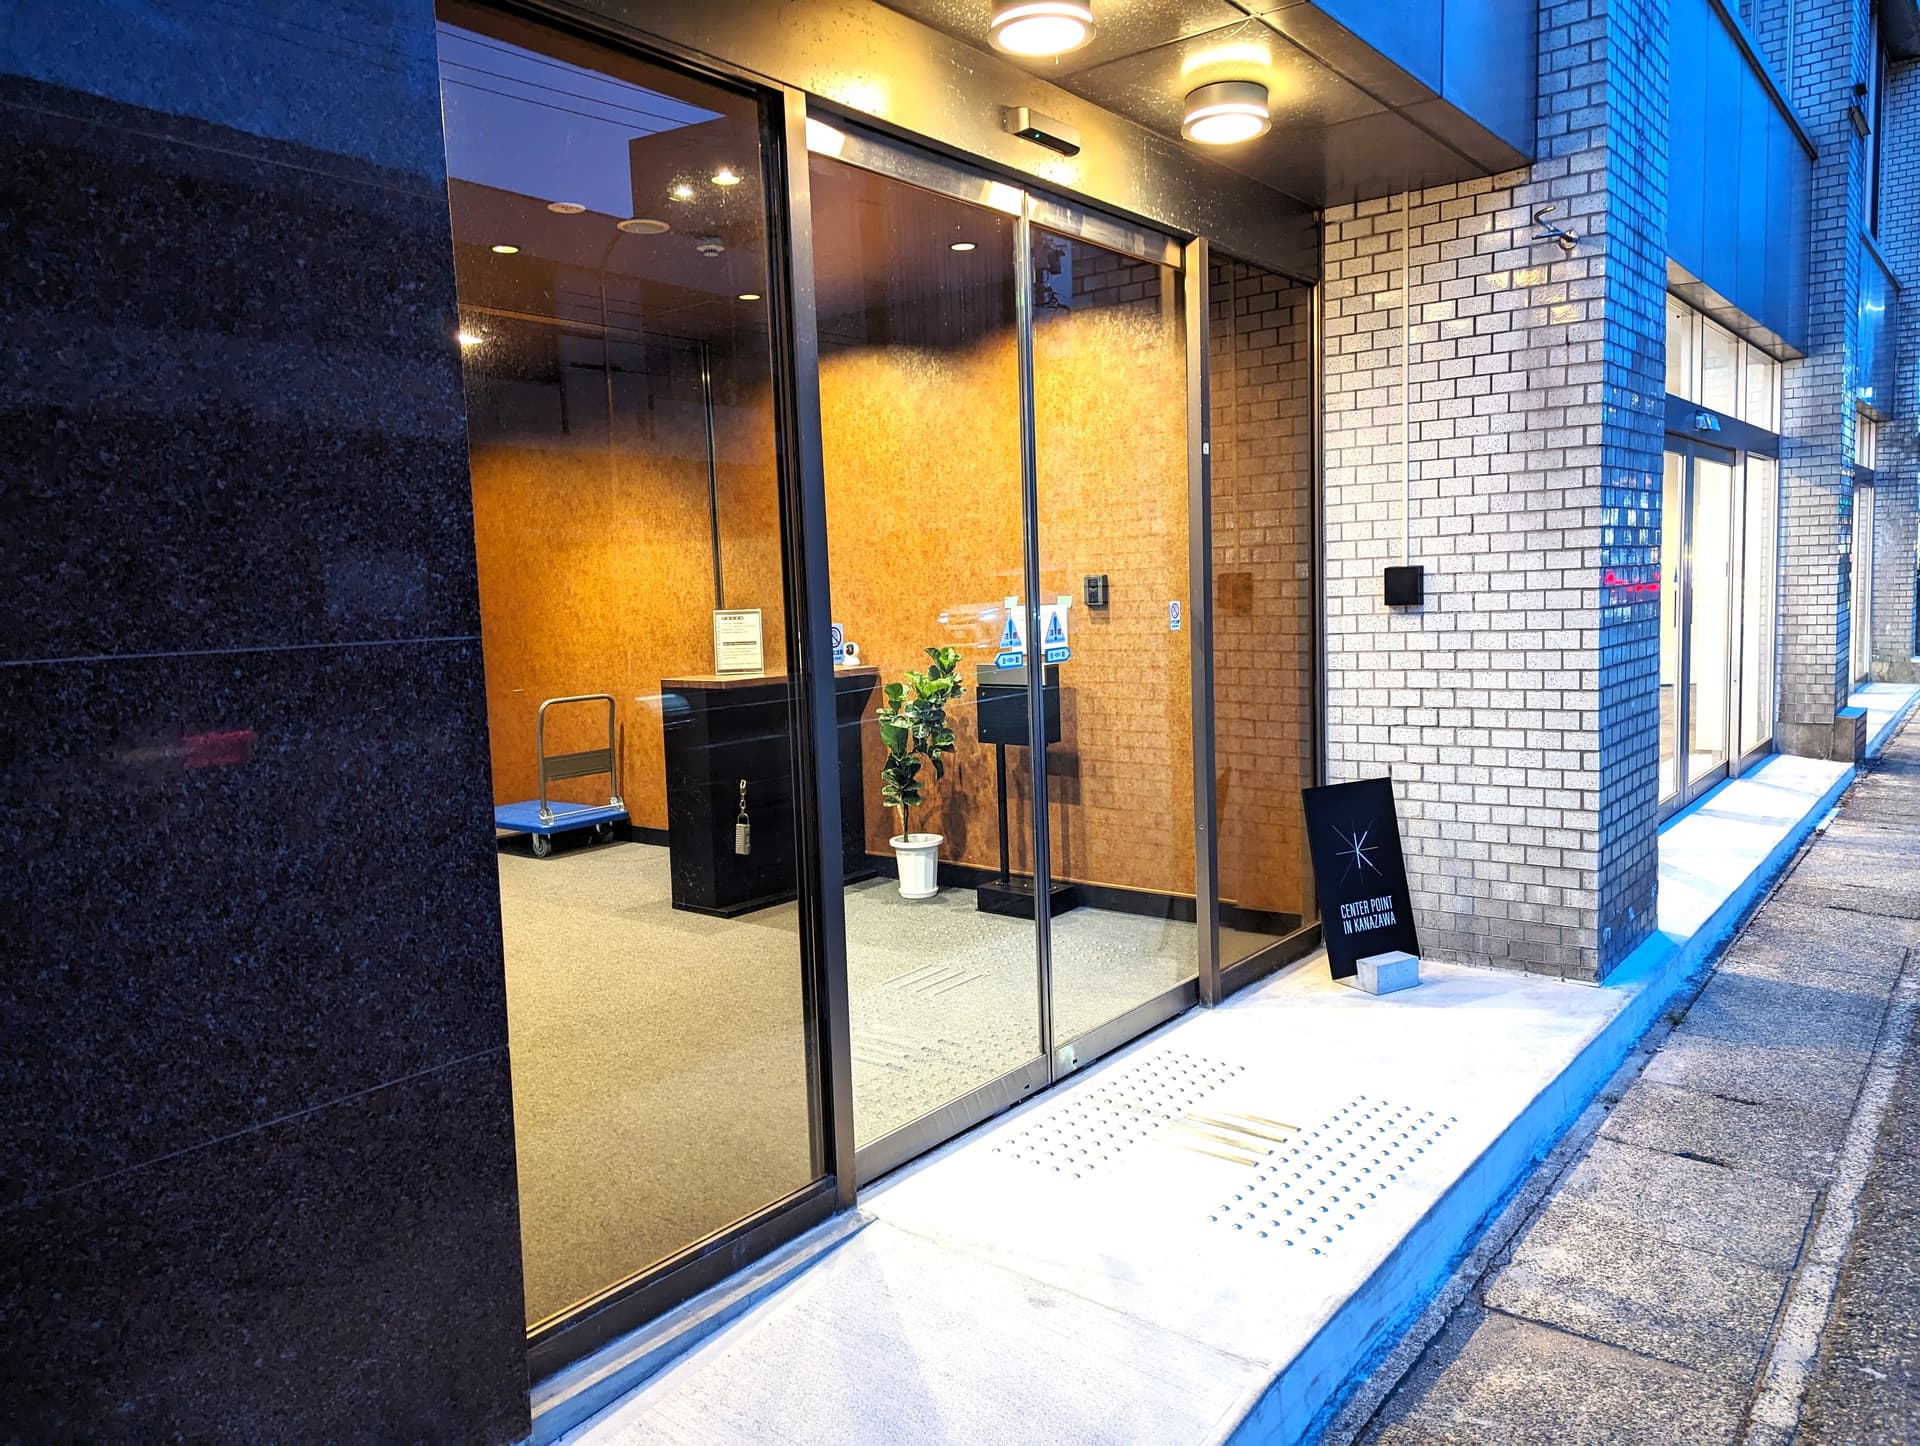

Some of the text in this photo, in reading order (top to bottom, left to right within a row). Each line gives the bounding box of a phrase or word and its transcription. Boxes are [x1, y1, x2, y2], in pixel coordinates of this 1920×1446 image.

[1340, 895, 1393, 919] CENTER POINT
[1343, 911, 1397, 935] IN KANAZAWA
